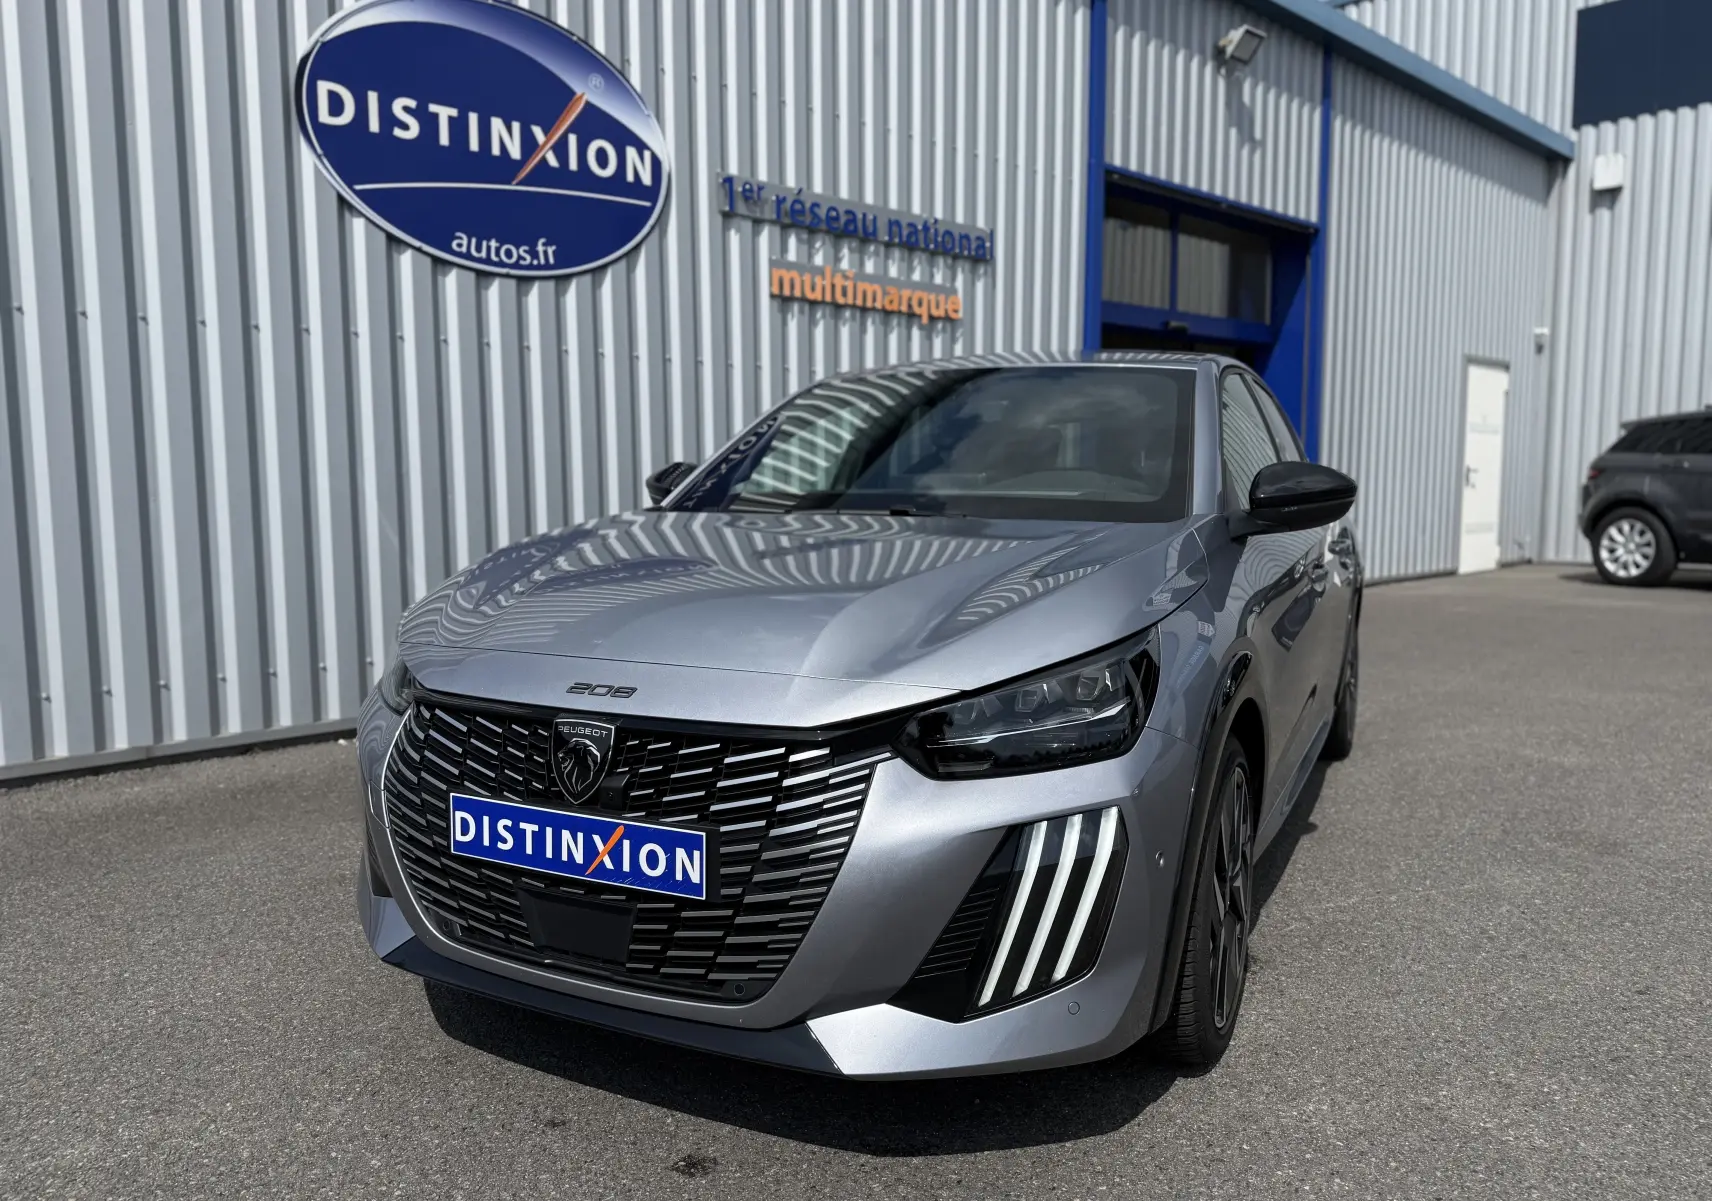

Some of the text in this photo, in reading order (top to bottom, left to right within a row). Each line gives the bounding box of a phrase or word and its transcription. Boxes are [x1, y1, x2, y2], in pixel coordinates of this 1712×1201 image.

[316, 79, 653, 187] DISTINXION
[722, 175, 994, 260] 1er réseau national
[451, 231, 557, 266] autos.fr
[770, 265, 964, 325] multimarque
[565, 681, 638, 699] 208
[557, 725, 608, 738] PEUGEOT
[454, 810, 701, 884] DISTINXION
